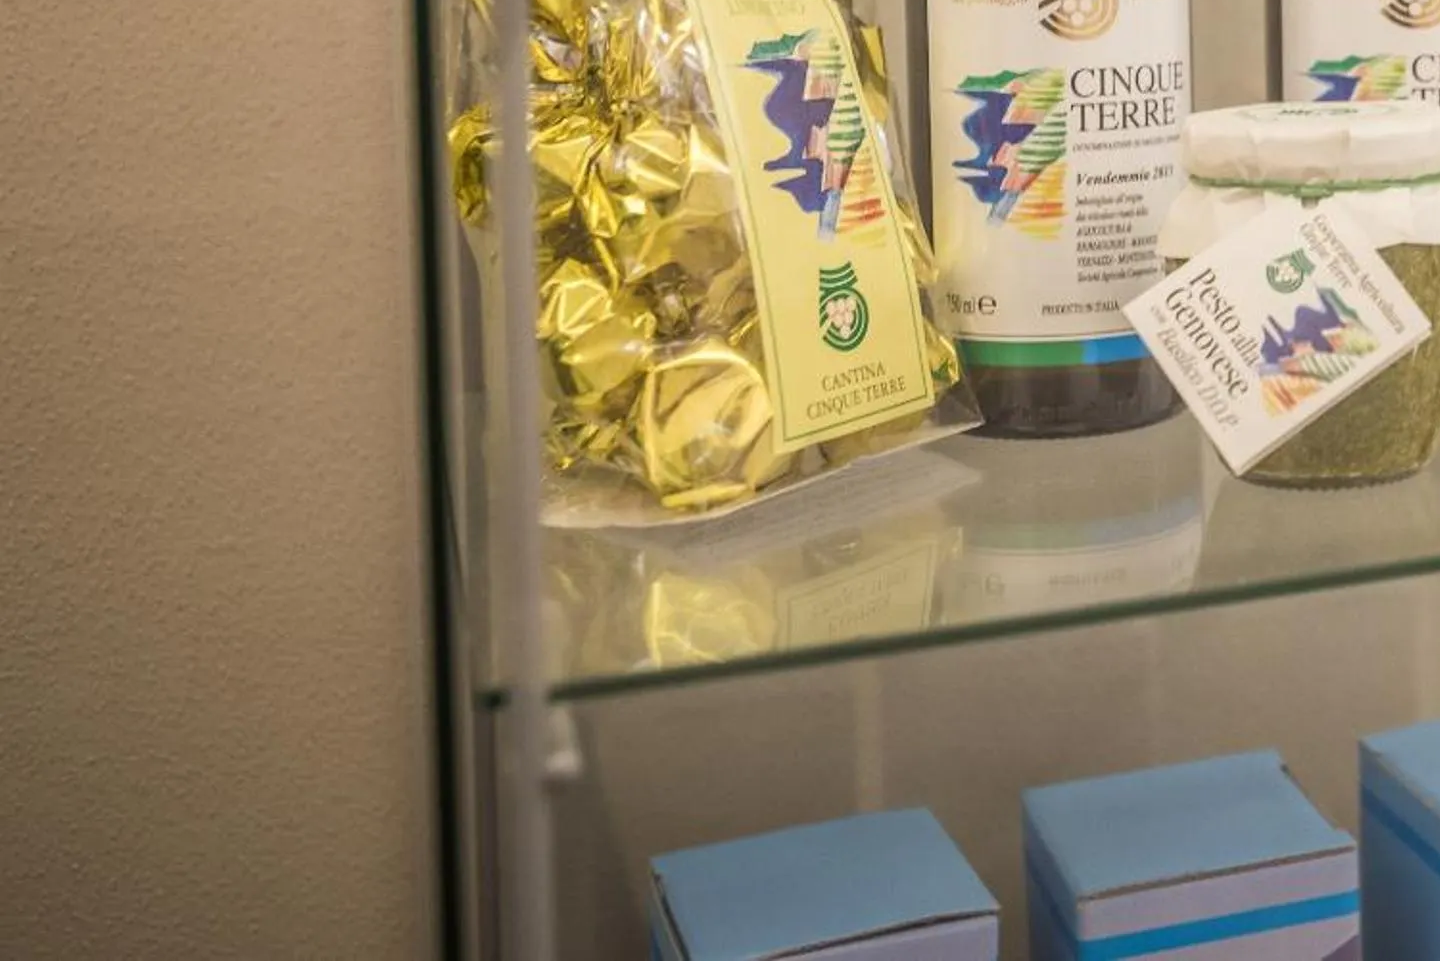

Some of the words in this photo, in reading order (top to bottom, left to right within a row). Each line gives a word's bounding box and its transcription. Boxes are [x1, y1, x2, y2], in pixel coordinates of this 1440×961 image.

[1070, 61, 1183, 98] CINQUE
[1070, 96, 1175, 132] TERRE
[1190, 268, 1240, 334] Pesto
[1231, 334, 1260, 367] alla
[1166, 286, 1248, 400] Genovese
[821, 360, 886, 391] CANTINA
[806, 389, 862, 421] CINQUE
[863, 375, 906, 402] TERRE
